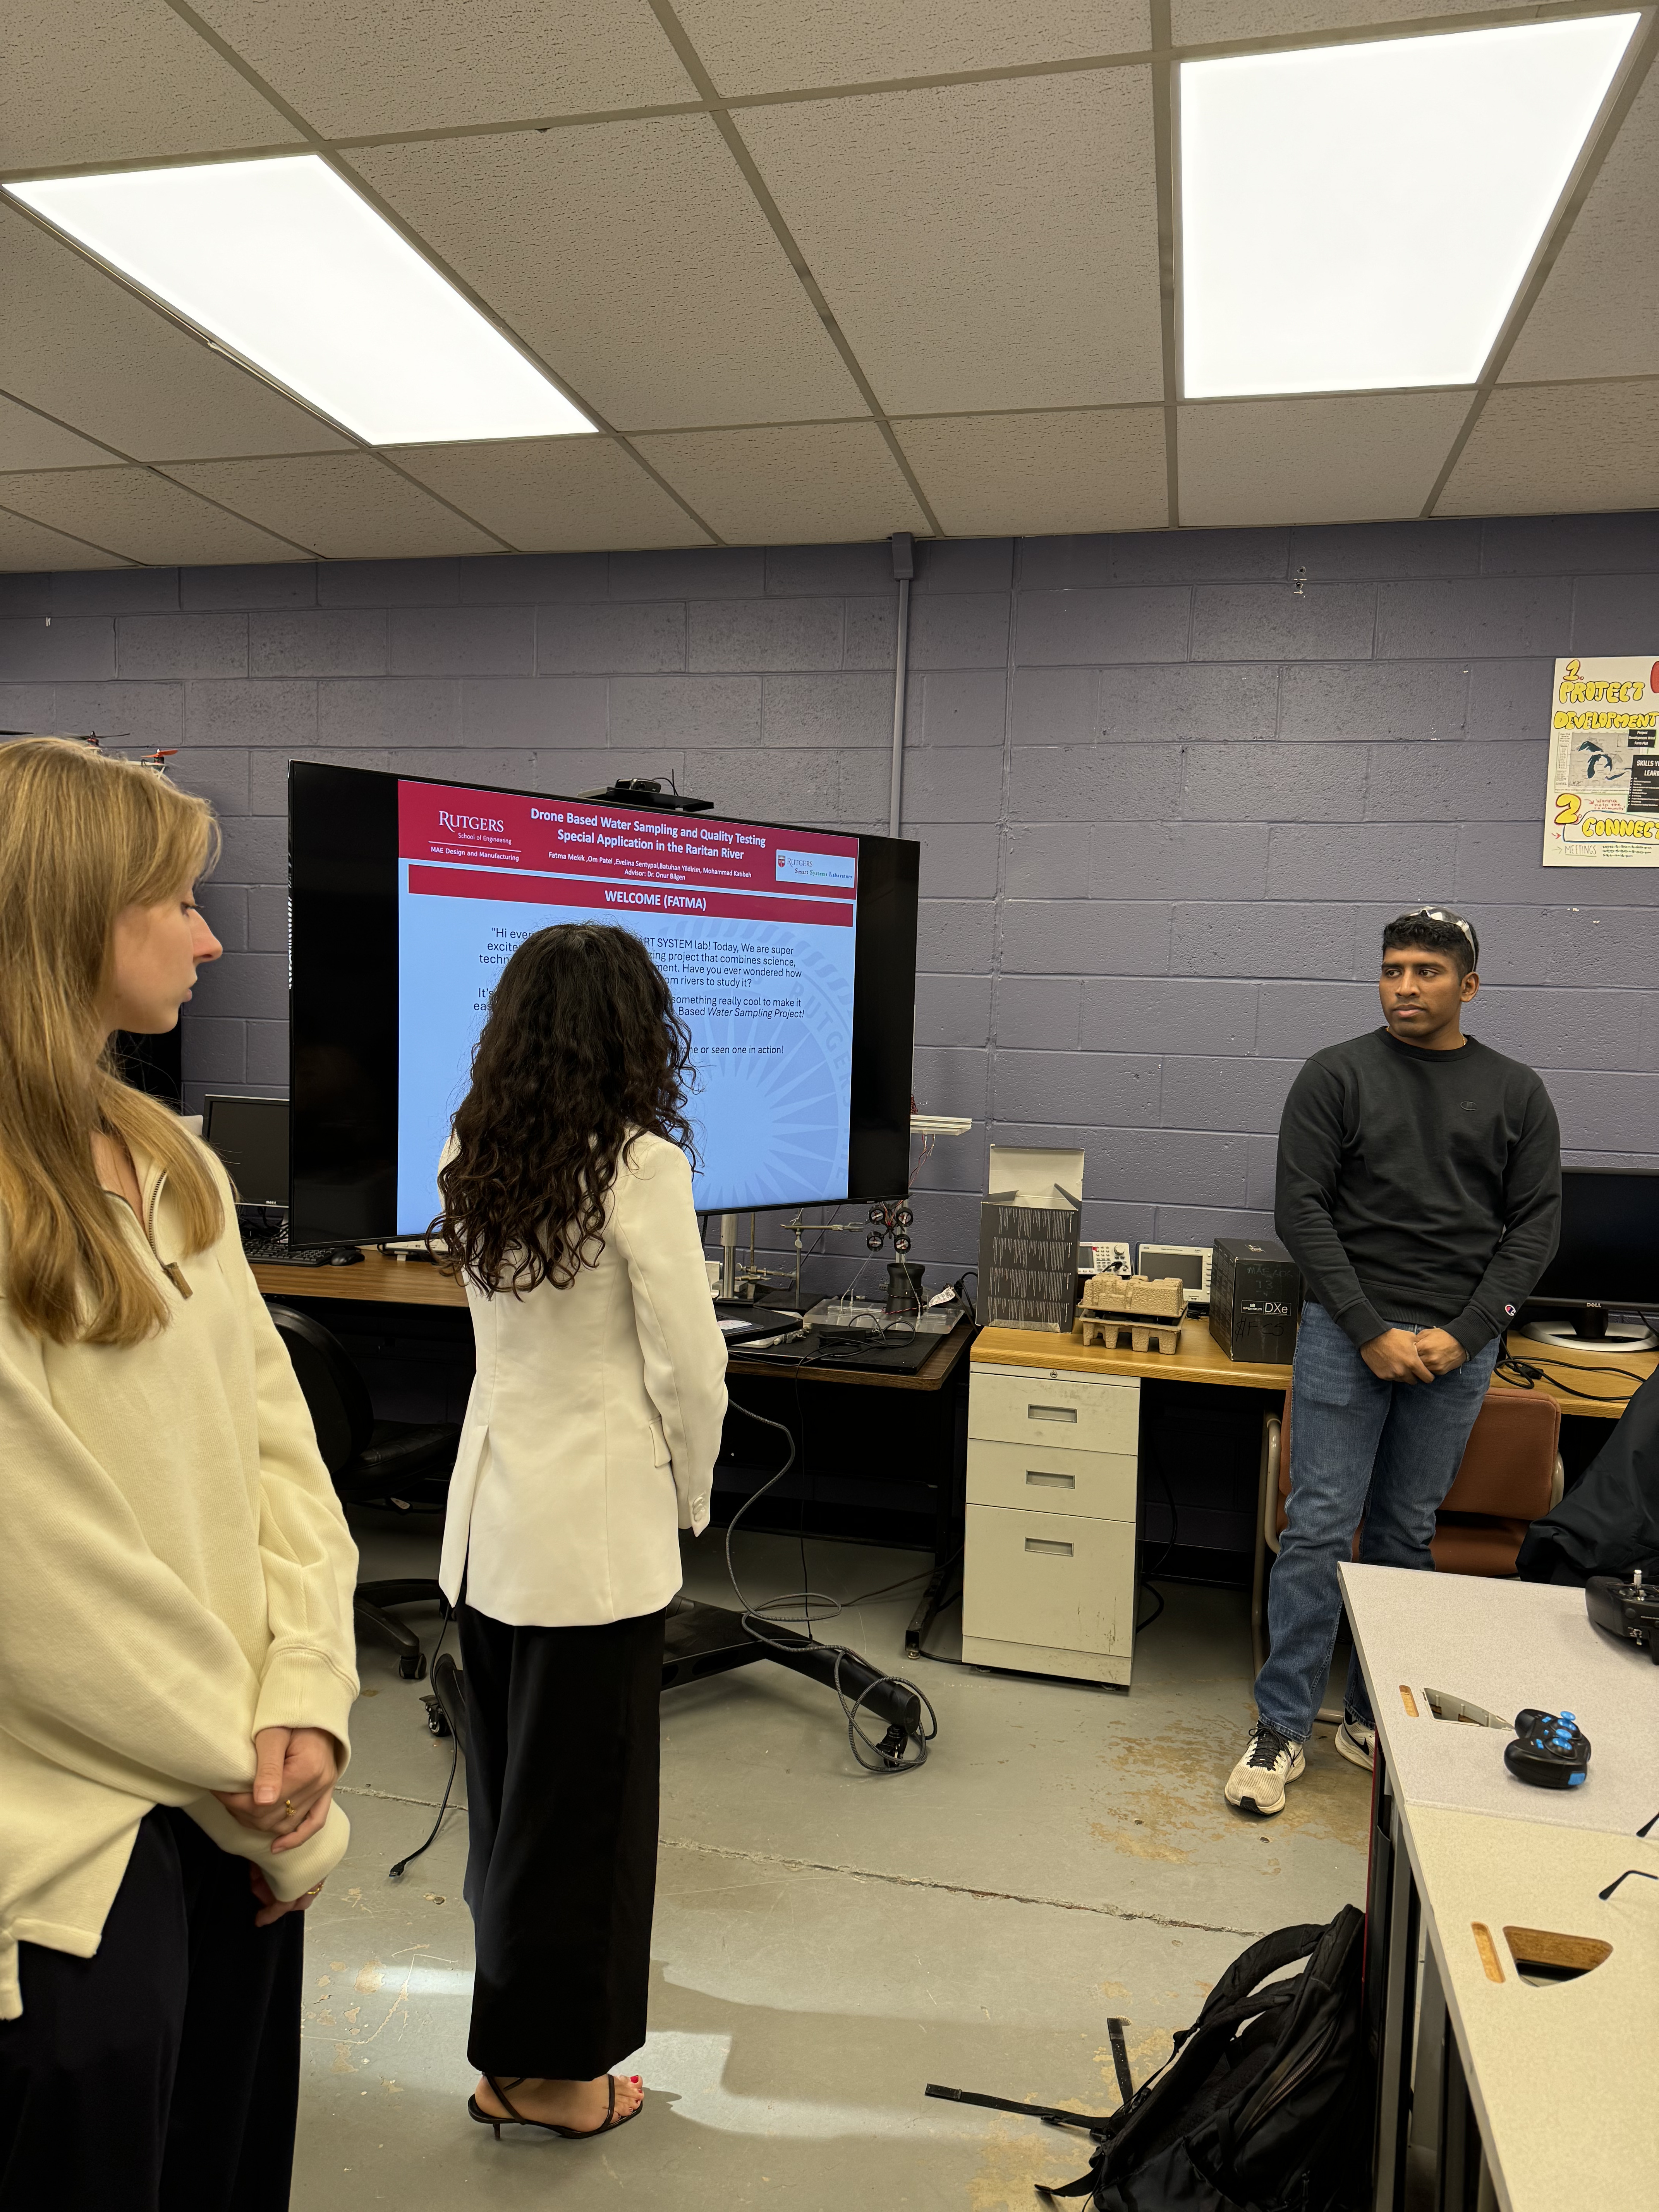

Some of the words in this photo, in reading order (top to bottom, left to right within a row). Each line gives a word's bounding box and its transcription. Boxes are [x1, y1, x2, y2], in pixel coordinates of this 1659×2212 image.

[1559, 681, 1645, 704] PROJECT
[1554, 711, 1659, 730] DEVELOPMENT
[439, 811, 504, 833] RUTGERS
[531, 808, 564, 822] Drone
[567, 812, 598, 826] Based
[600, 816, 632, 830] Water
[634, 821, 678, 838] Sampling
[680, 828, 697, 838] and
[700, 829, 733, 844] Quality
[735, 833, 766, 848] Testing
[483, 835, 512, 845] Engineering
[558, 829, 594, 843] Special
[597, 834, 653, 850] Application
[656, 840, 665, 851] in
[667, 842, 683, 853] the
[686, 844, 718, 857] Raritan
[721, 848, 744, 860] River
[445, 848, 465, 857] Design
[479, 852, 519, 862] Manufacturing
[1565, 845, 1597, 854] MEETINGS
[549, 852, 566, 860] Fatma
[568, 854, 585, 862] Mekik
[682, 865, 702, 874] Yildirim,
[703, 868, 732, 876] Mohammad
[787, 857, 813, 867] RUTGERS
[829, 871, 853, 879] Laboratory
[605, 890, 661, 905] WELCOME
[664, 895, 706, 911] (FATMA)
[491, 927, 507, 938] "Hi
[510, 931, 534, 939] ever
[641, 937, 655, 946] RT
[658, 938, 692, 949] SYSTEM
[695, 940, 710, 950] lab!
[713, 941, 738, 953] Today,
[741, 943, 754, 952] We
[771, 947, 794, 956] super
[488, 942, 520, 952] excite
[668, 952, 699, 963] project
[701, 953, 718, 962] that
[720, 955, 761, 964] combines
[763, 957, 796, 967] science,
[479, 954, 509, 964] techn
[683, 964, 704, 973] Have
[707, 967, 721, 975] you
[743, 968, 783, 977] wondered
[785, 969, 802, 977] how
[681, 976, 704, 985] rivers
[707, 977, 714, 986] to
[717, 978, 740, 988] study
[742, 978, 752, 987] it?
[672, 995, 716, 1006] something
[719, 996, 741, 1007] really
[744, 997, 761, 1006] cool
[773, 998, 794, 1006] make
[797, 998, 801, 1007] it
[678, 1006, 705, 1016] Based
[708, 1007, 733, 1016] Water
[734, 1008, 773, 1019] Sampling
[775, 1009, 804, 1019] Project!
[749, 1045, 756, 1053] in
[758, 1045, 783, 1054] action!
[1265, 1302, 1288, 1313] DXe
